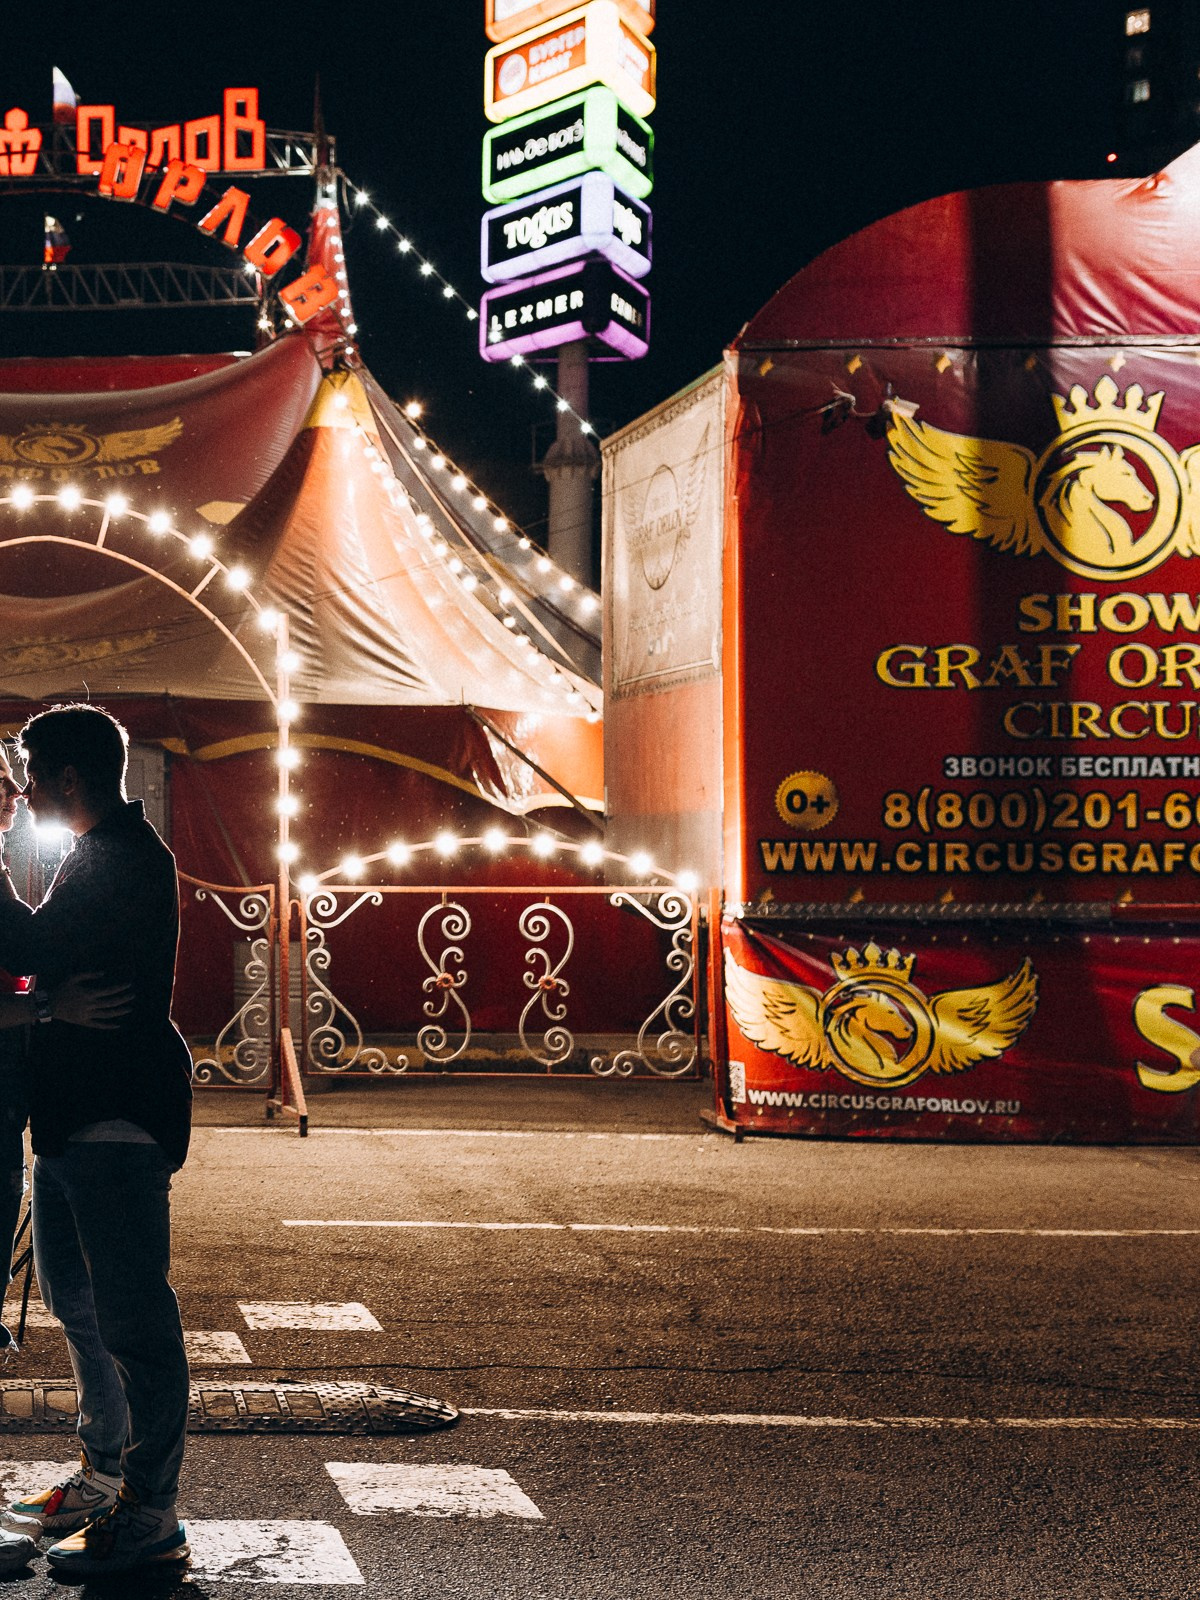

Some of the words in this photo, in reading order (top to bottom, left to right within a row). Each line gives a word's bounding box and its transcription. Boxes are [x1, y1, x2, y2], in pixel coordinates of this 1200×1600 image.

[97, 141, 339, 325] ОРЛОВ
[491, 290, 584, 331] LEXMER
[1018, 593, 1200, 633] SHOW
[876, 643, 1080, 691] GRAF
[1002, 701, 1200, 741] CIRCU
[944, 756, 1052, 777] ЗВОНОК
[784, 788, 832, 815] 0+
[884, 788, 1200, 834] 8(800)201-6
[748, 1089, 1021, 1115] WWW.CIRCUSGRAFORLOV.RU
